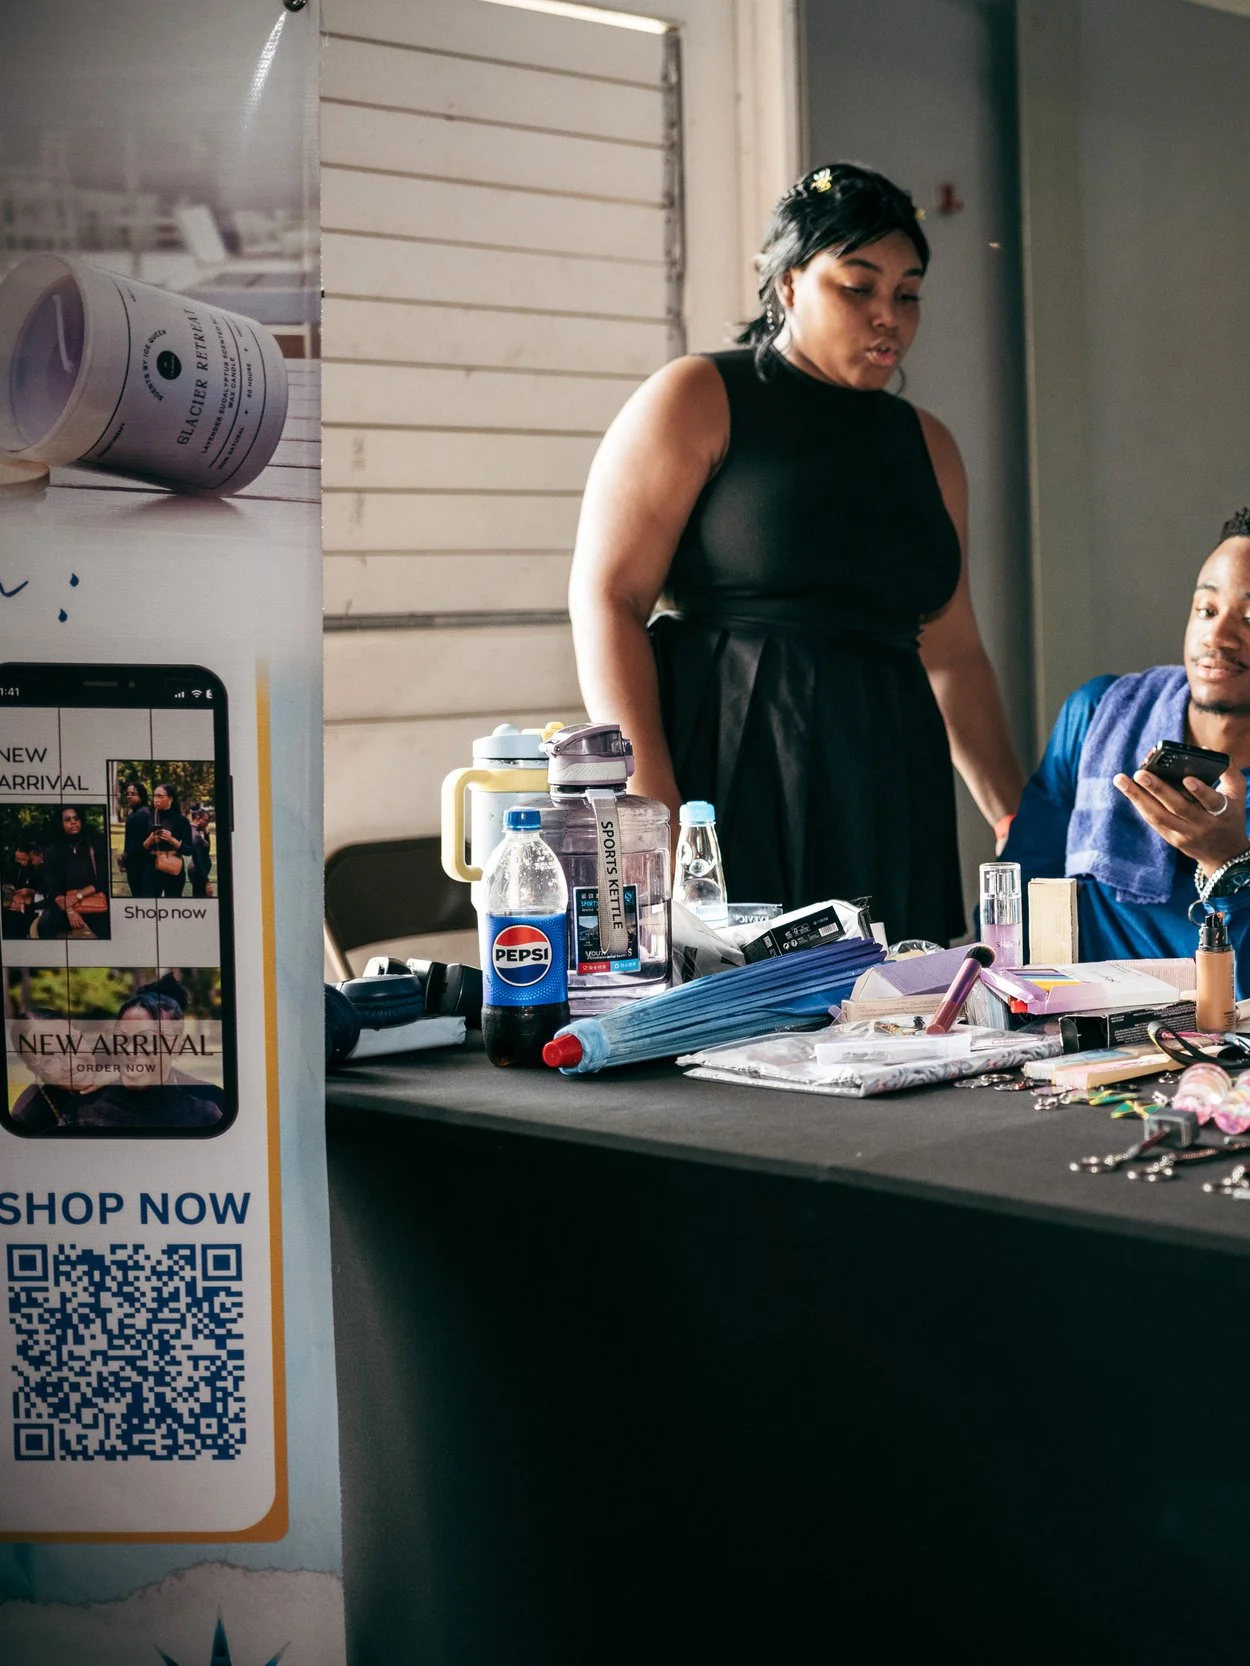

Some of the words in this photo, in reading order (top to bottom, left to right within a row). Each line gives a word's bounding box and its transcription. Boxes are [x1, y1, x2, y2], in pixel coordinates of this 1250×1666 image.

[143, 344, 151, 357] ICE
[184, 309, 208, 372] RETREAT
[216, 326, 228, 359] SCENTED
[142, 361, 149, 371] BY
[229, 357, 237, 389] CANDLE
[218, 361, 230, 415] EUCALYPTUS
[228, 391, 236, 409] WAX
[176, 379, 208, 445] GLACIER
[201, 416, 222, 454] LAVENDER
[227, 426, 245, 455] NATURAL
[0, 747, 48, 763] NEW
[0, 774, 89, 791] ARRIVAL
[601, 820, 618, 875] SPORTS
[124, 906, 173, 921] Shop
[172, 907, 207, 919] now
[608, 878, 624, 930] KETTLE
[495, 948, 549, 962] PEPSI
[19, 1034, 83, 1056] NEW
[92, 1034, 214, 1056] ARRIVAL
[77, 1064, 121, 1073] ORDER
[126, 1064, 156, 1073] NOW
[0, 1192, 124, 1225] SHOP
[140, 1192, 251, 1225] NOW
